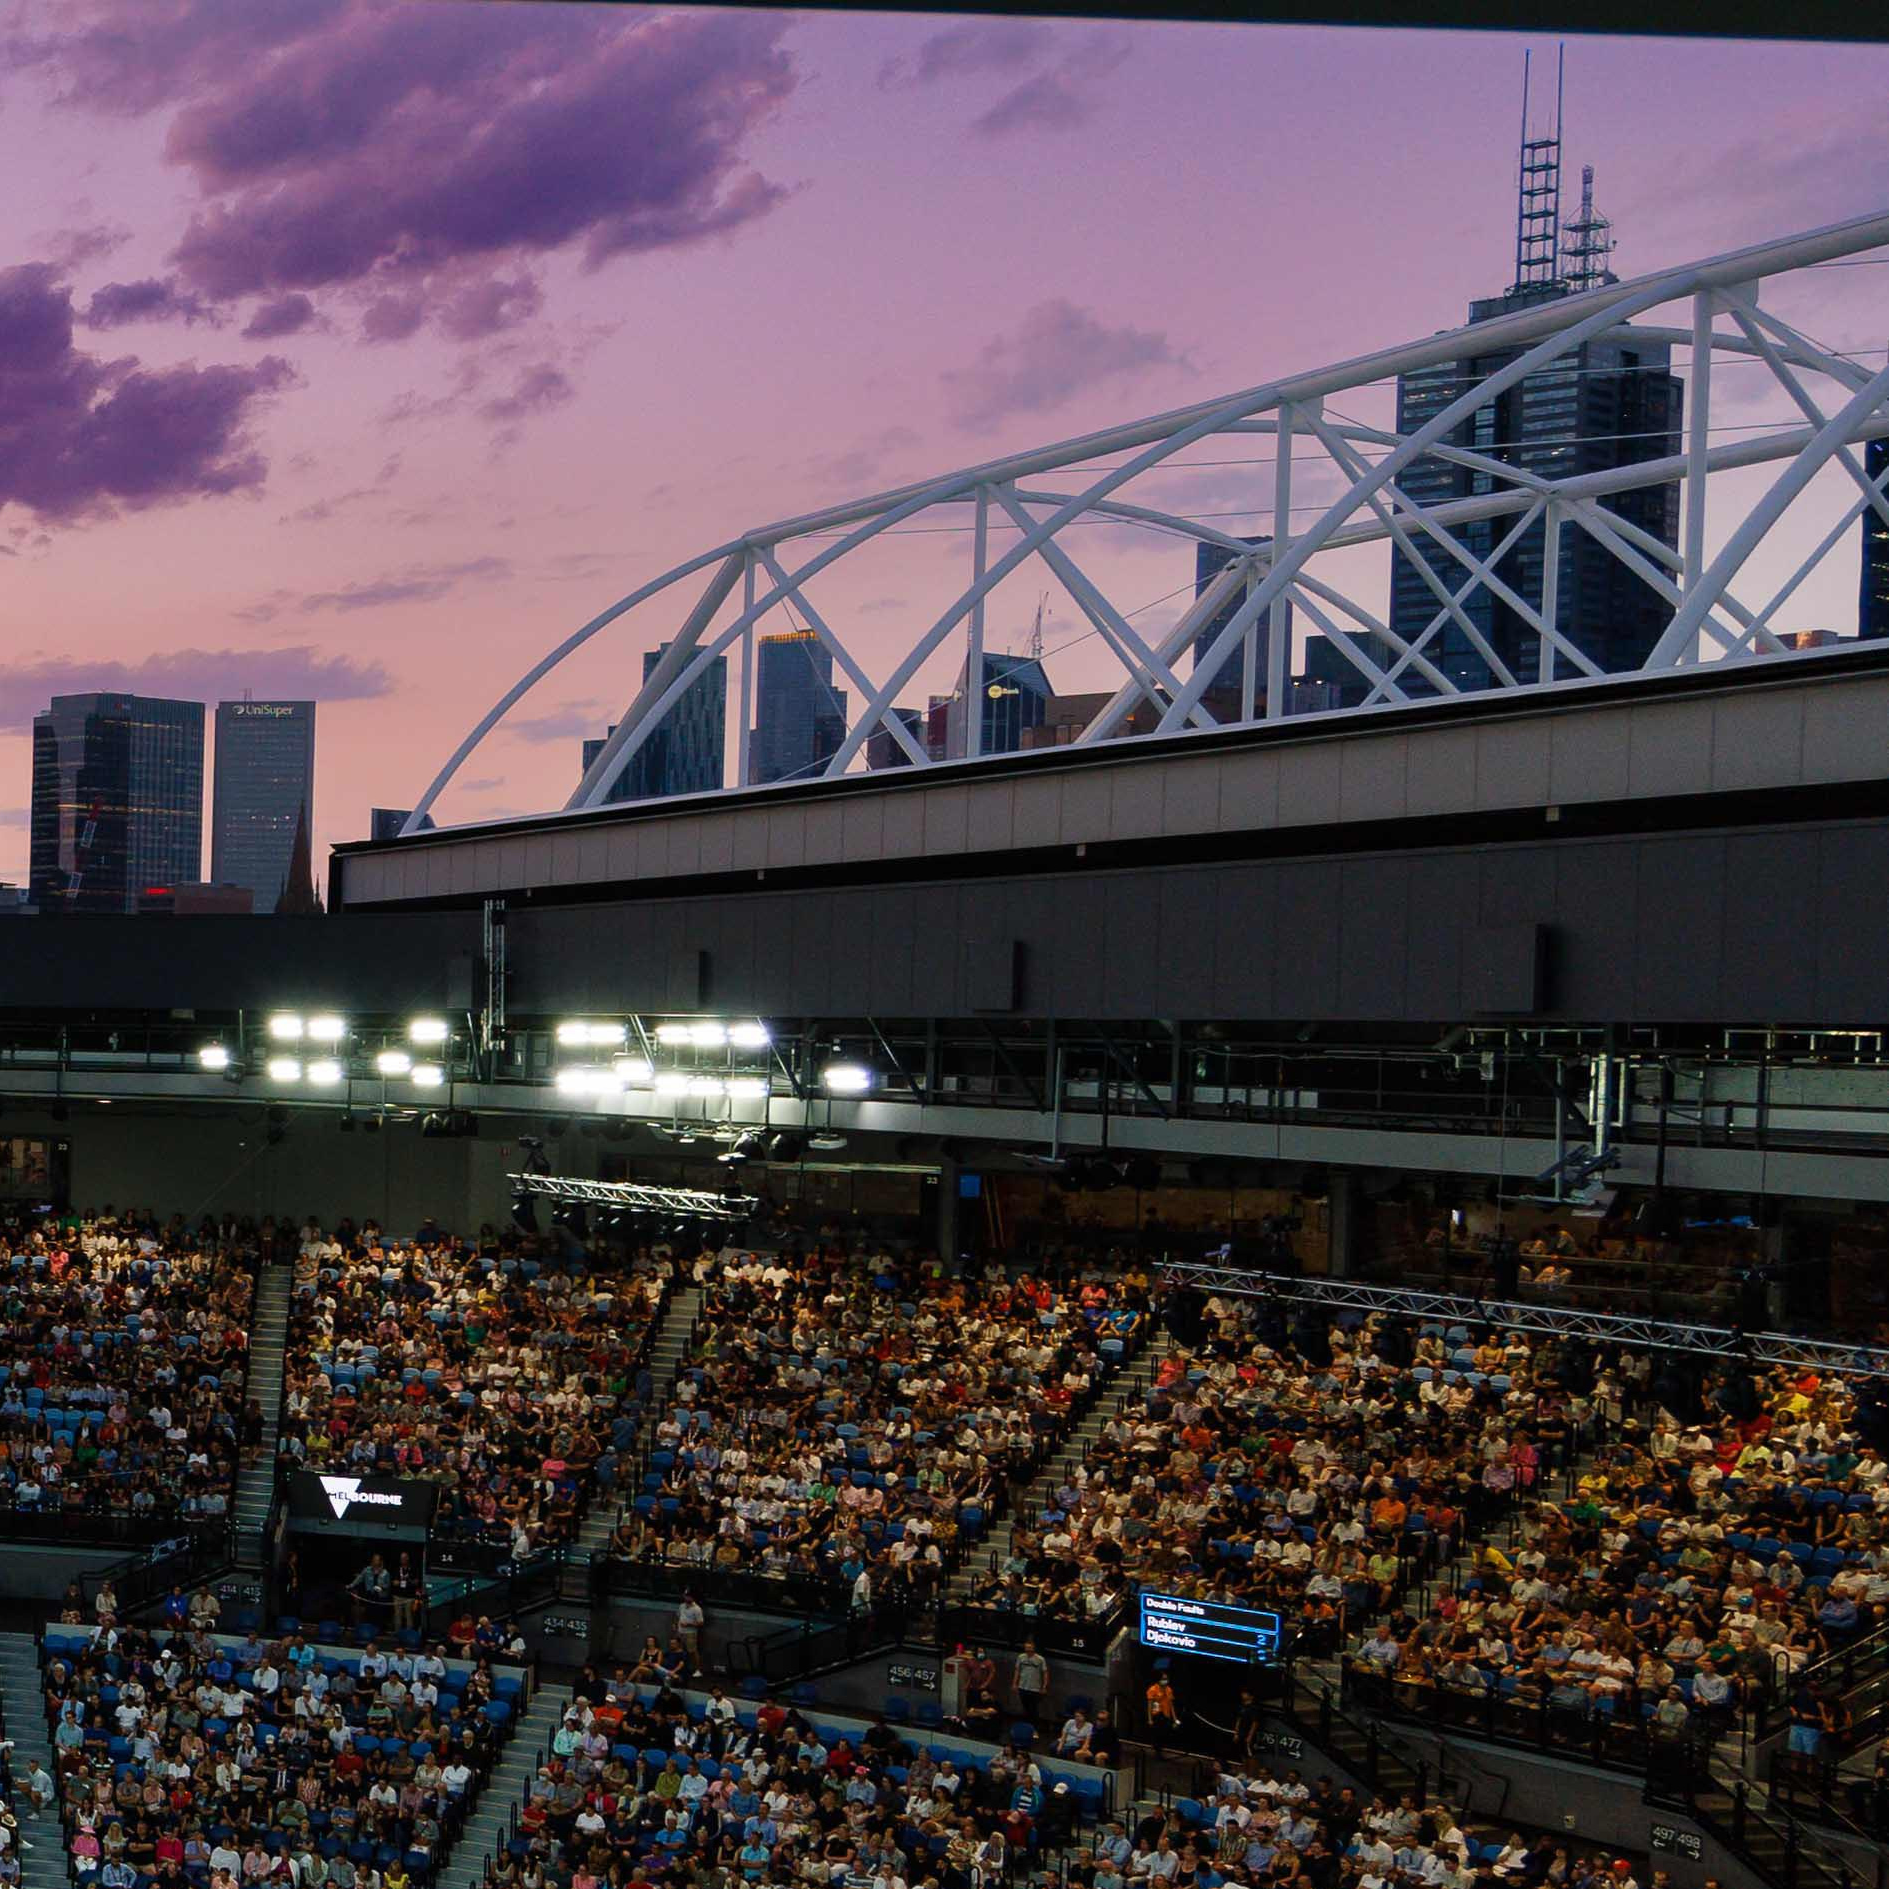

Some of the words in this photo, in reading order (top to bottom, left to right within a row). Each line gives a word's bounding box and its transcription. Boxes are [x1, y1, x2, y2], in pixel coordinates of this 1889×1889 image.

[245, 704, 294, 718] UniSuper
[328, 1491, 403, 1506] MELBOURNE
[441, 1554, 453, 1562] 14
[1147, 1616, 1186, 1633] Rublev
[1256, 1635, 1266, 1645] 2
[889, 1665, 912, 1678] 456
[914, 1669, 936, 1682] 457
[1279, 1736, 1303, 1749] 477
[1653, 1827, 1675, 1840] 497
[1677, 1834, 1701, 1849] 498
